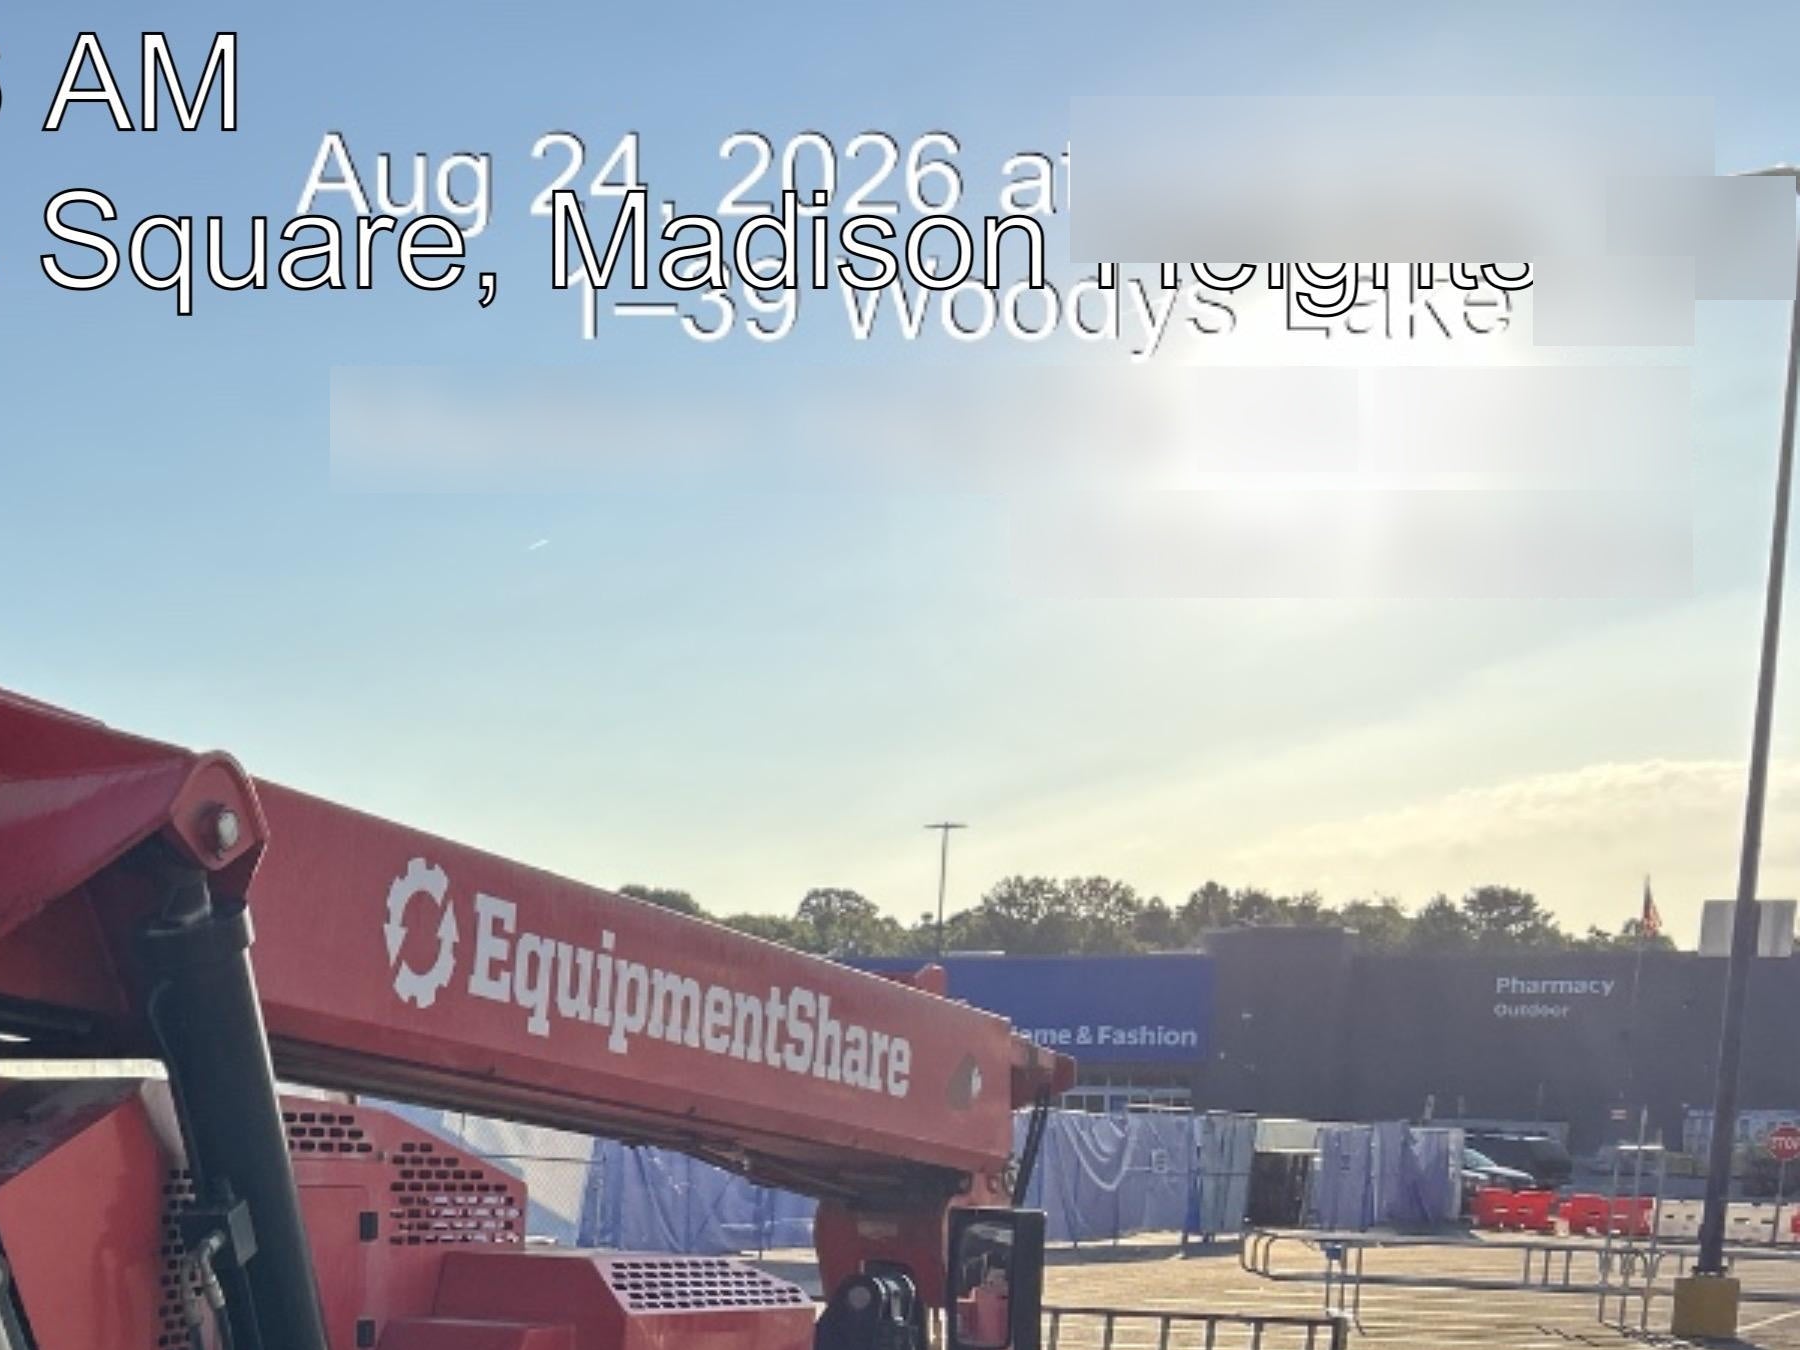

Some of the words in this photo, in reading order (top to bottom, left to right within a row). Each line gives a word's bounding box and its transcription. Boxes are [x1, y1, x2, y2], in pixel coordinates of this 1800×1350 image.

[467, 893, 913, 1098] EquipmentShare
[1495, 977, 1615, 997] Pharmacy
[1493, 1002, 1570, 1018] Outdoor
[1076, 1026, 1093, 1046] &
[1097, 1025, 1197, 1047] Fashion
